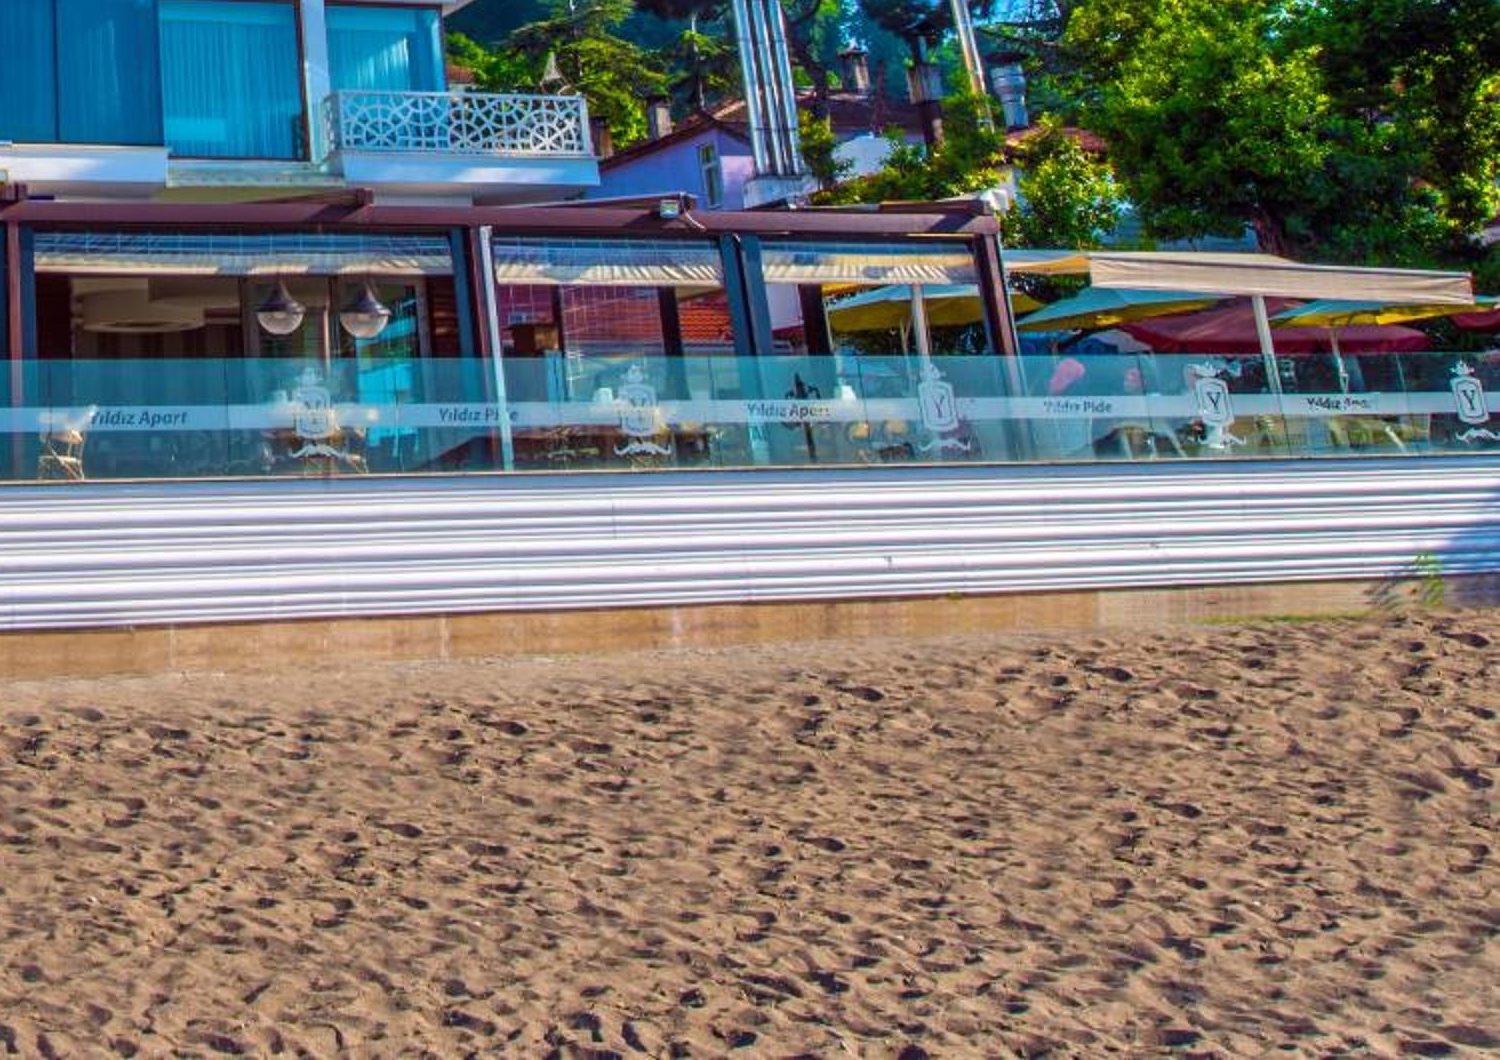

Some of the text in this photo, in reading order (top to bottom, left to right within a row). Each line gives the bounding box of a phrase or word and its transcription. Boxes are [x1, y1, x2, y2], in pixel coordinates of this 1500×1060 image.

[1206, 390, 1221, 415] Y
[1460, 388, 1478, 412] Y
[138, 411, 188, 428] Apart
